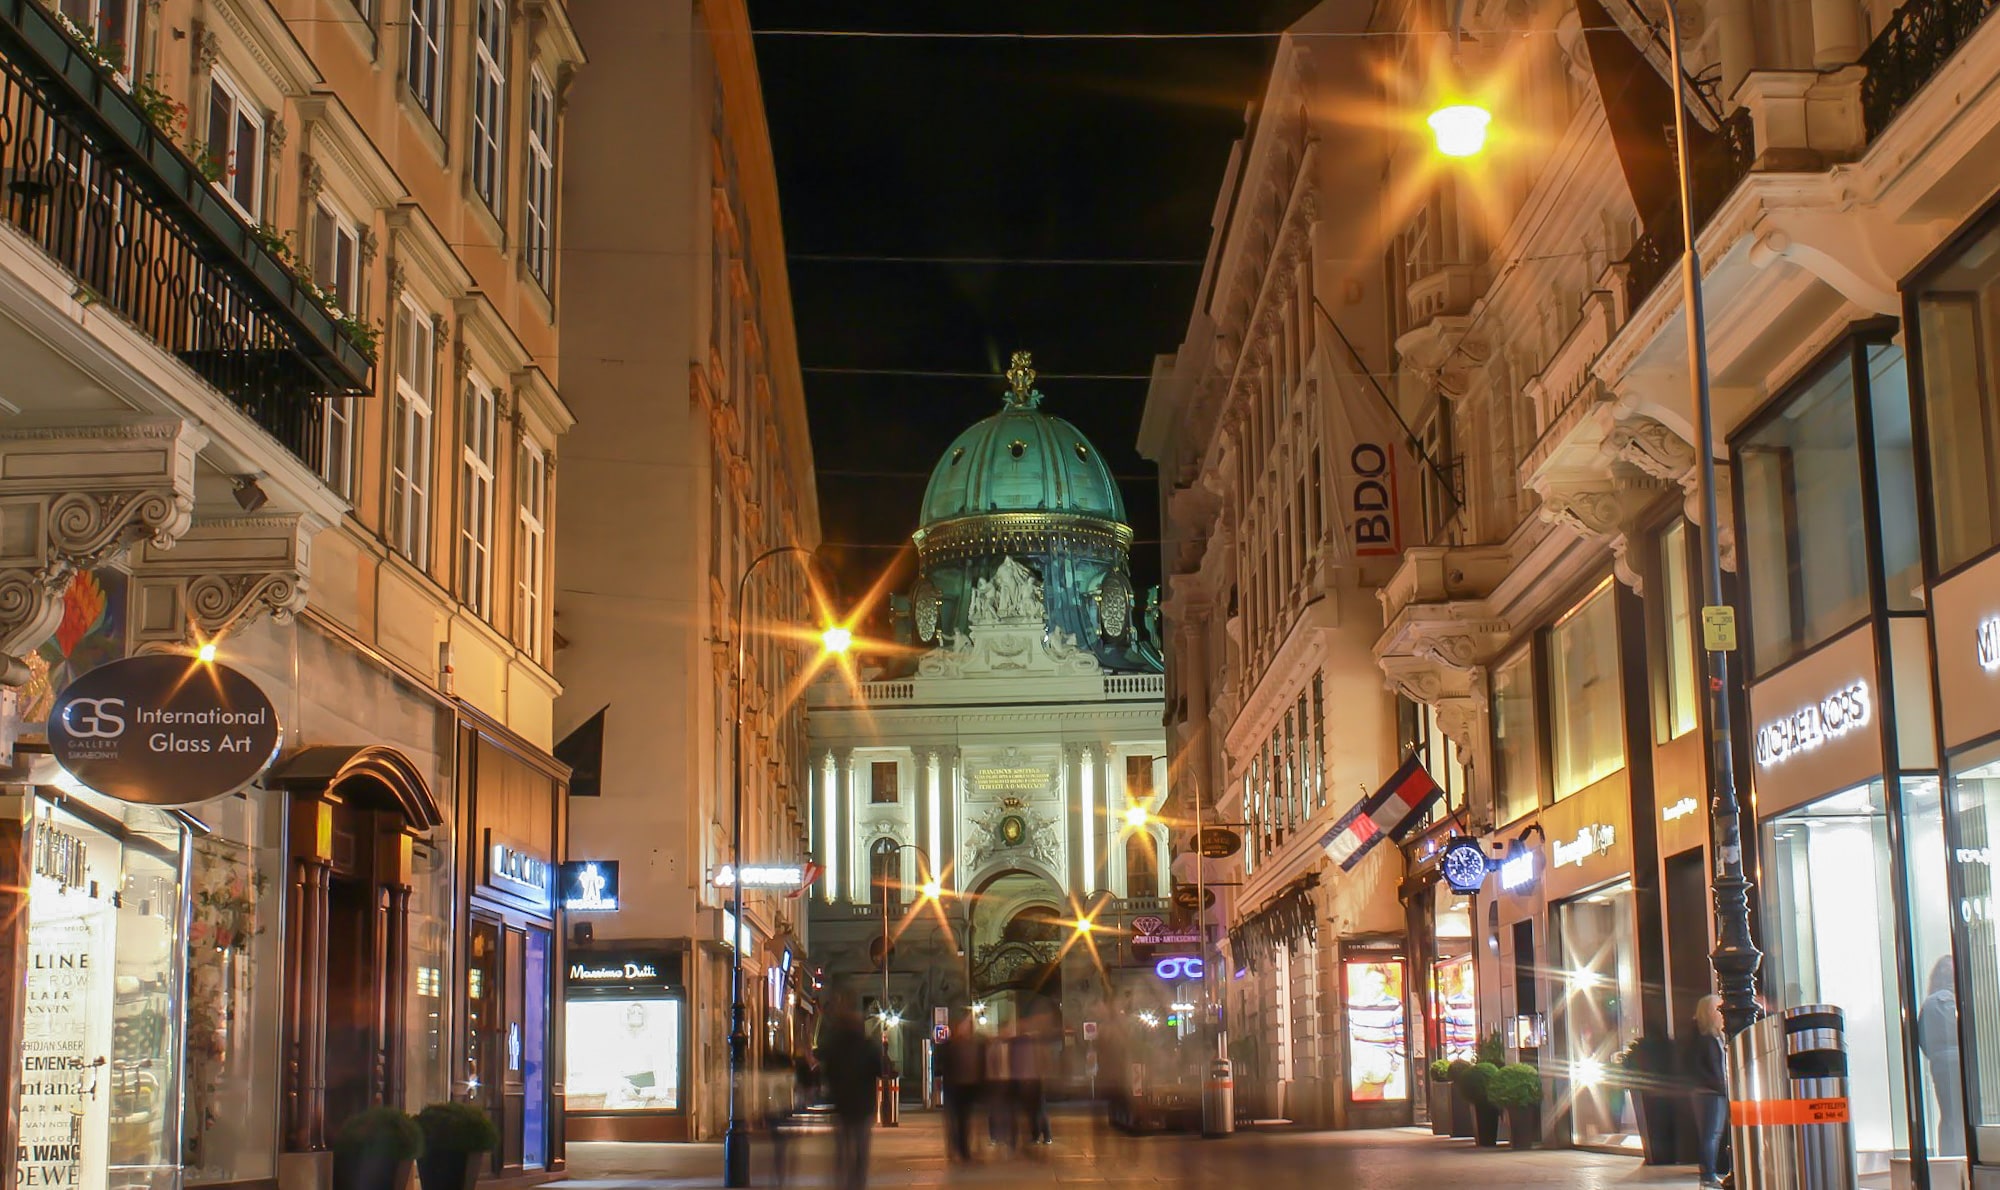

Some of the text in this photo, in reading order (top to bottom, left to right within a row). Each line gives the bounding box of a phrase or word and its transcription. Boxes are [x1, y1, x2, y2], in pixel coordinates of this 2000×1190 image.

[1351, 443, 1391, 544] BDO
[62, 697, 125, 738] GS
[136, 707, 265, 725] International
[1756, 684, 1867, 766] MICHAEL KORS
[149, 733, 252, 752] Glass Art
[35, 953, 88, 969] LINE
[570, 963, 657, 980] Massimo Dutti
[33, 1144, 80, 1161] WANG
